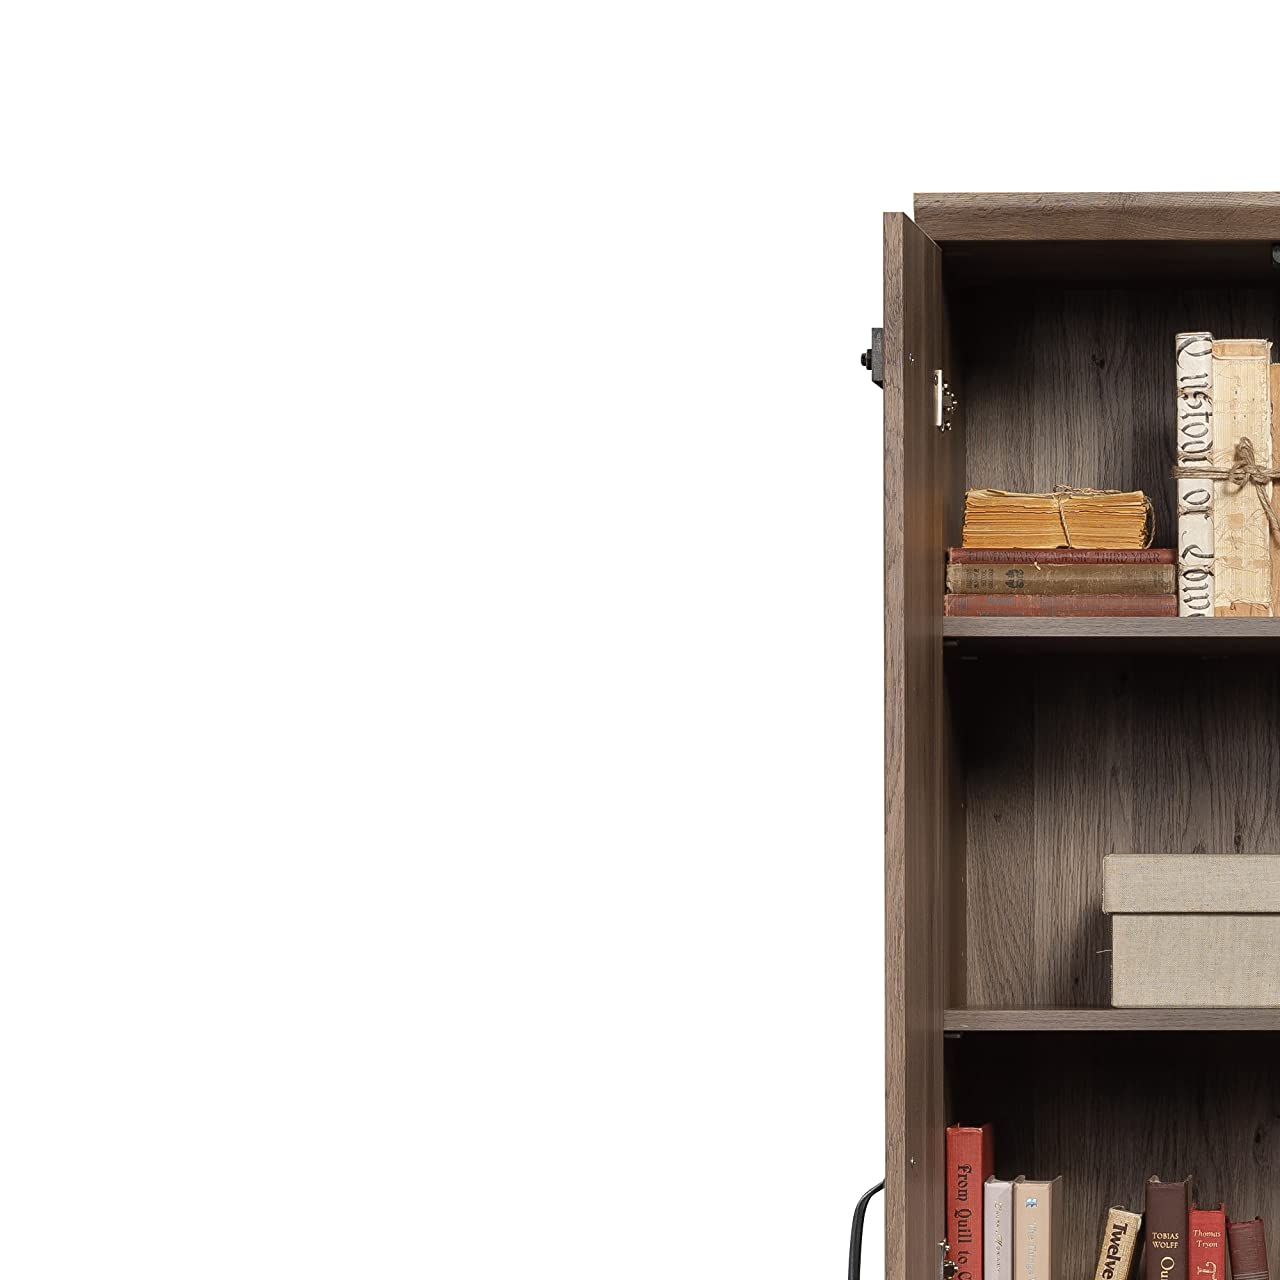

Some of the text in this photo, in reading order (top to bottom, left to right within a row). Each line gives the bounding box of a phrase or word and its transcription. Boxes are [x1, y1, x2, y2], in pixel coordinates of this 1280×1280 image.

[967, 552, 1039, 564] ELEMENTARY
[1094, 552, 1129, 563] THIRD
[1131, 552, 1161, 563] YEAR
[957, 1163, 973, 1202] From
[954, 1208, 973, 1244] Quill
[1152, 1232, 1180, 1240] TOBIAS
[1193, 1229, 1221, 1238] Thomas
[1152, 1241, 1179, 1249] WOLFF
[1196, 1240, 1218, 1249] Tryon
[1101, 1223, 1128, 1280] Twelve
[957, 1251, 972, 1265] to
